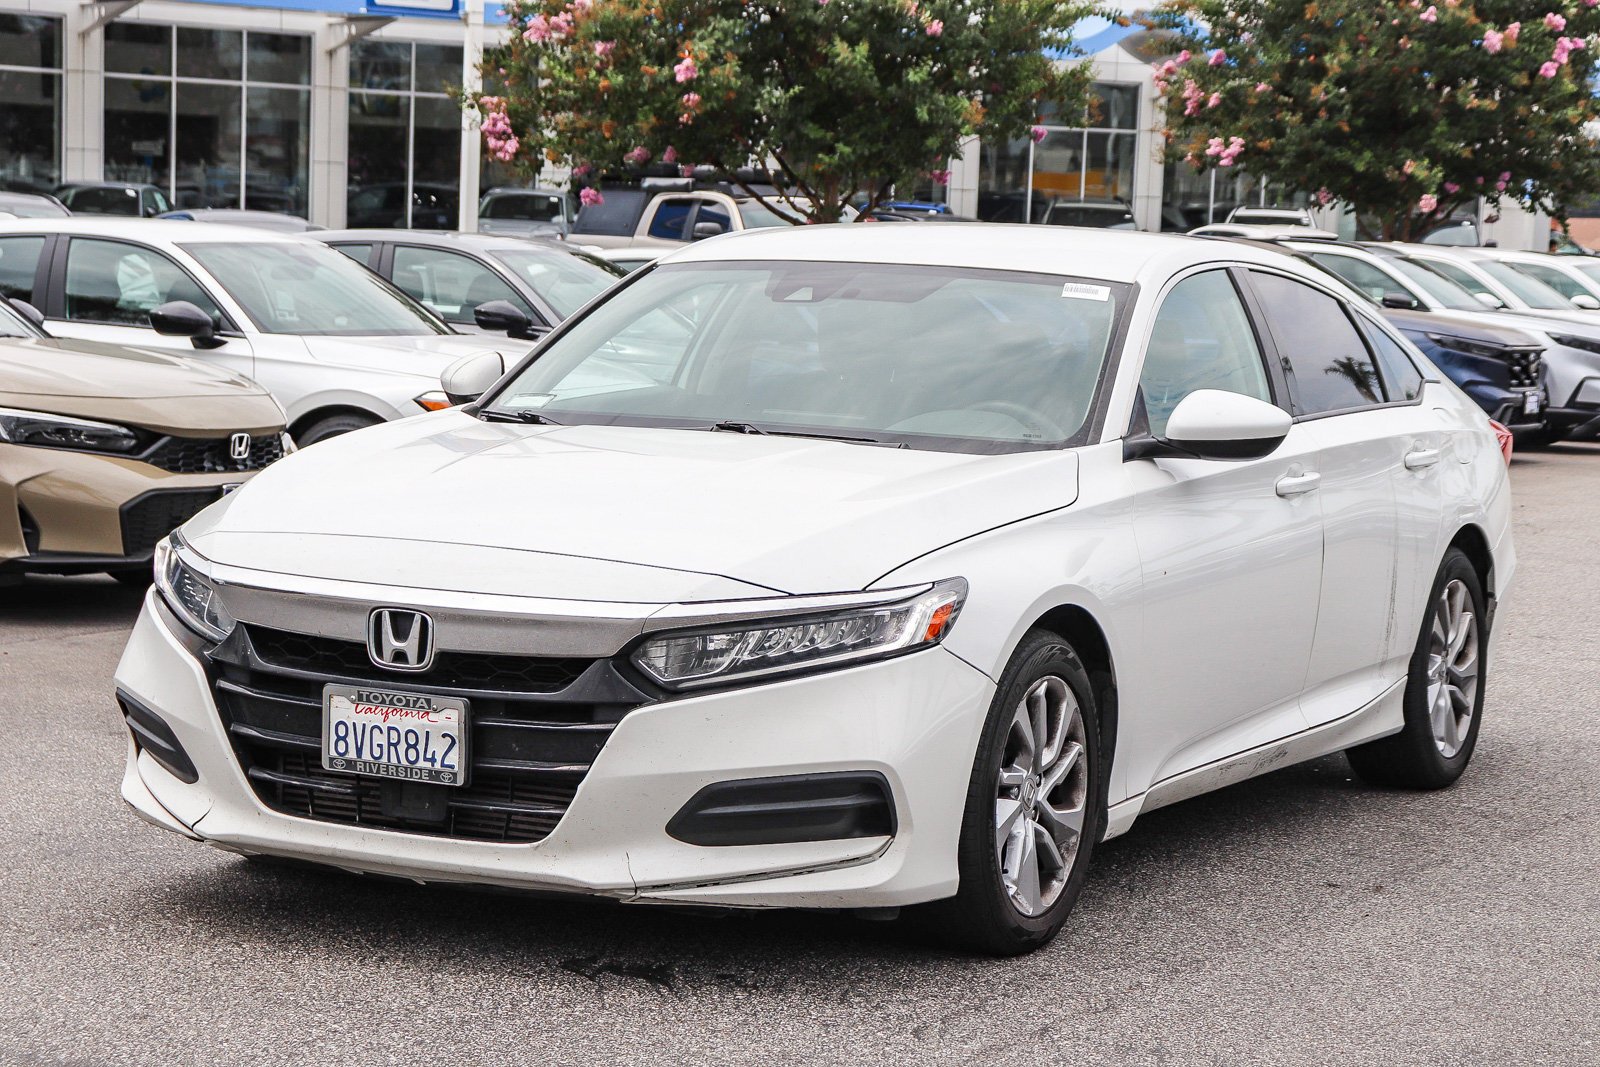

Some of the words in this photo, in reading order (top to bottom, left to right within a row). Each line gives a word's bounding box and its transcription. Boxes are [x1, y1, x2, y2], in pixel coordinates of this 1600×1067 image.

[381, 610, 422, 666] H
[354, 703, 439, 723] California
[359, 691, 429, 709] TOYOTA
[334, 720, 457, 770] 8VGR842
